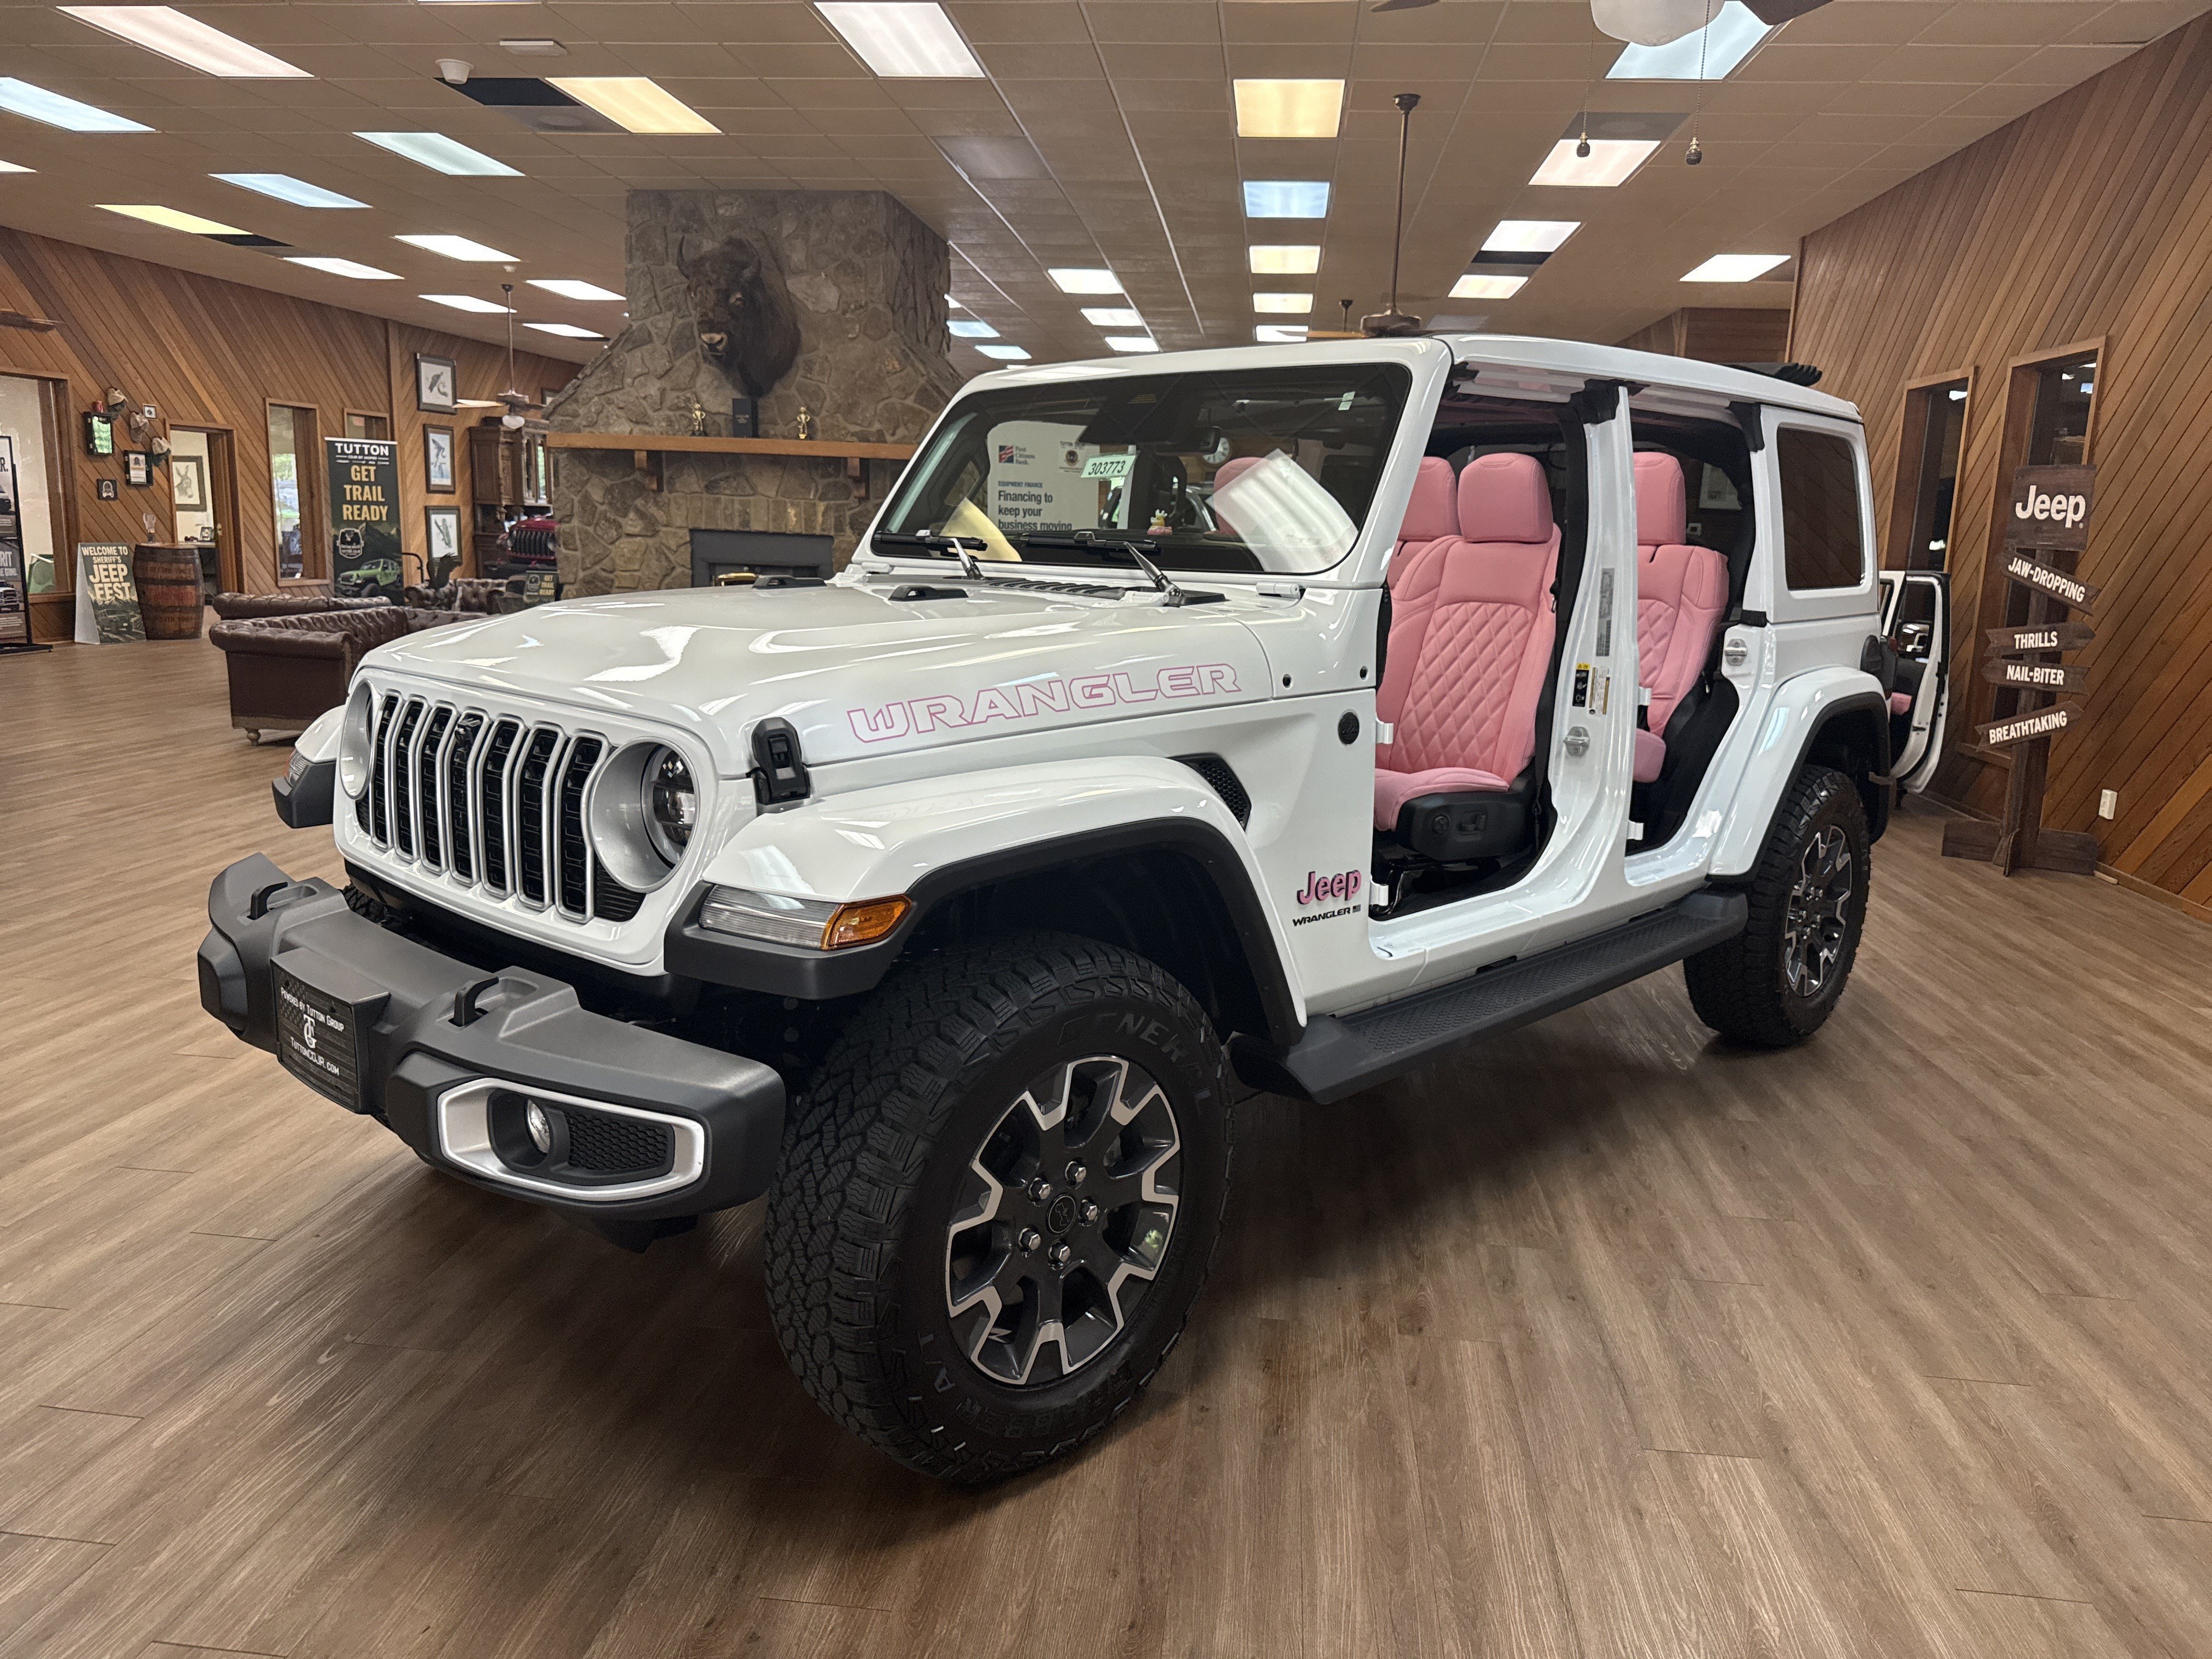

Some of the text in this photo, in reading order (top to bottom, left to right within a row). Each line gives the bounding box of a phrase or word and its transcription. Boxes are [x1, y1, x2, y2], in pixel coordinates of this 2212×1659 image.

[335, 443, 389, 456] TUTTON
[351, 465, 376, 482] GET
[1088, 460, 1126, 476] 303773
[343, 484, 385, 501] TRAIL
[998, 490, 1053, 504] Financing to
[342, 504, 388, 521] READY
[998, 505, 1042, 518] keep your
[2016, 485, 2086, 528] Jeep
[998, 519, 1073, 531] business moving
[82, 546, 128, 556] WELCOME TO
[89, 563, 127, 583] JEEP
[2008, 557, 2085, 602] JAW-DROPPING
[94, 582, 130, 600] FEST
[2014, 631, 2058, 650] THRILLS
[2006, 665, 2064, 685] NAIL-BITER
[847, 663, 1242, 743] WRANGLER
[1989, 710, 2067, 744] BREATHTAKING
[1297, 870, 1362, 905] Jeep
[1293, 907, 1351, 927] WRANGLER
[281, 987, 345, 1032] POWERED BY TUTTON GROUP
[1056, 1012, 1211, 1117] GNERAL
